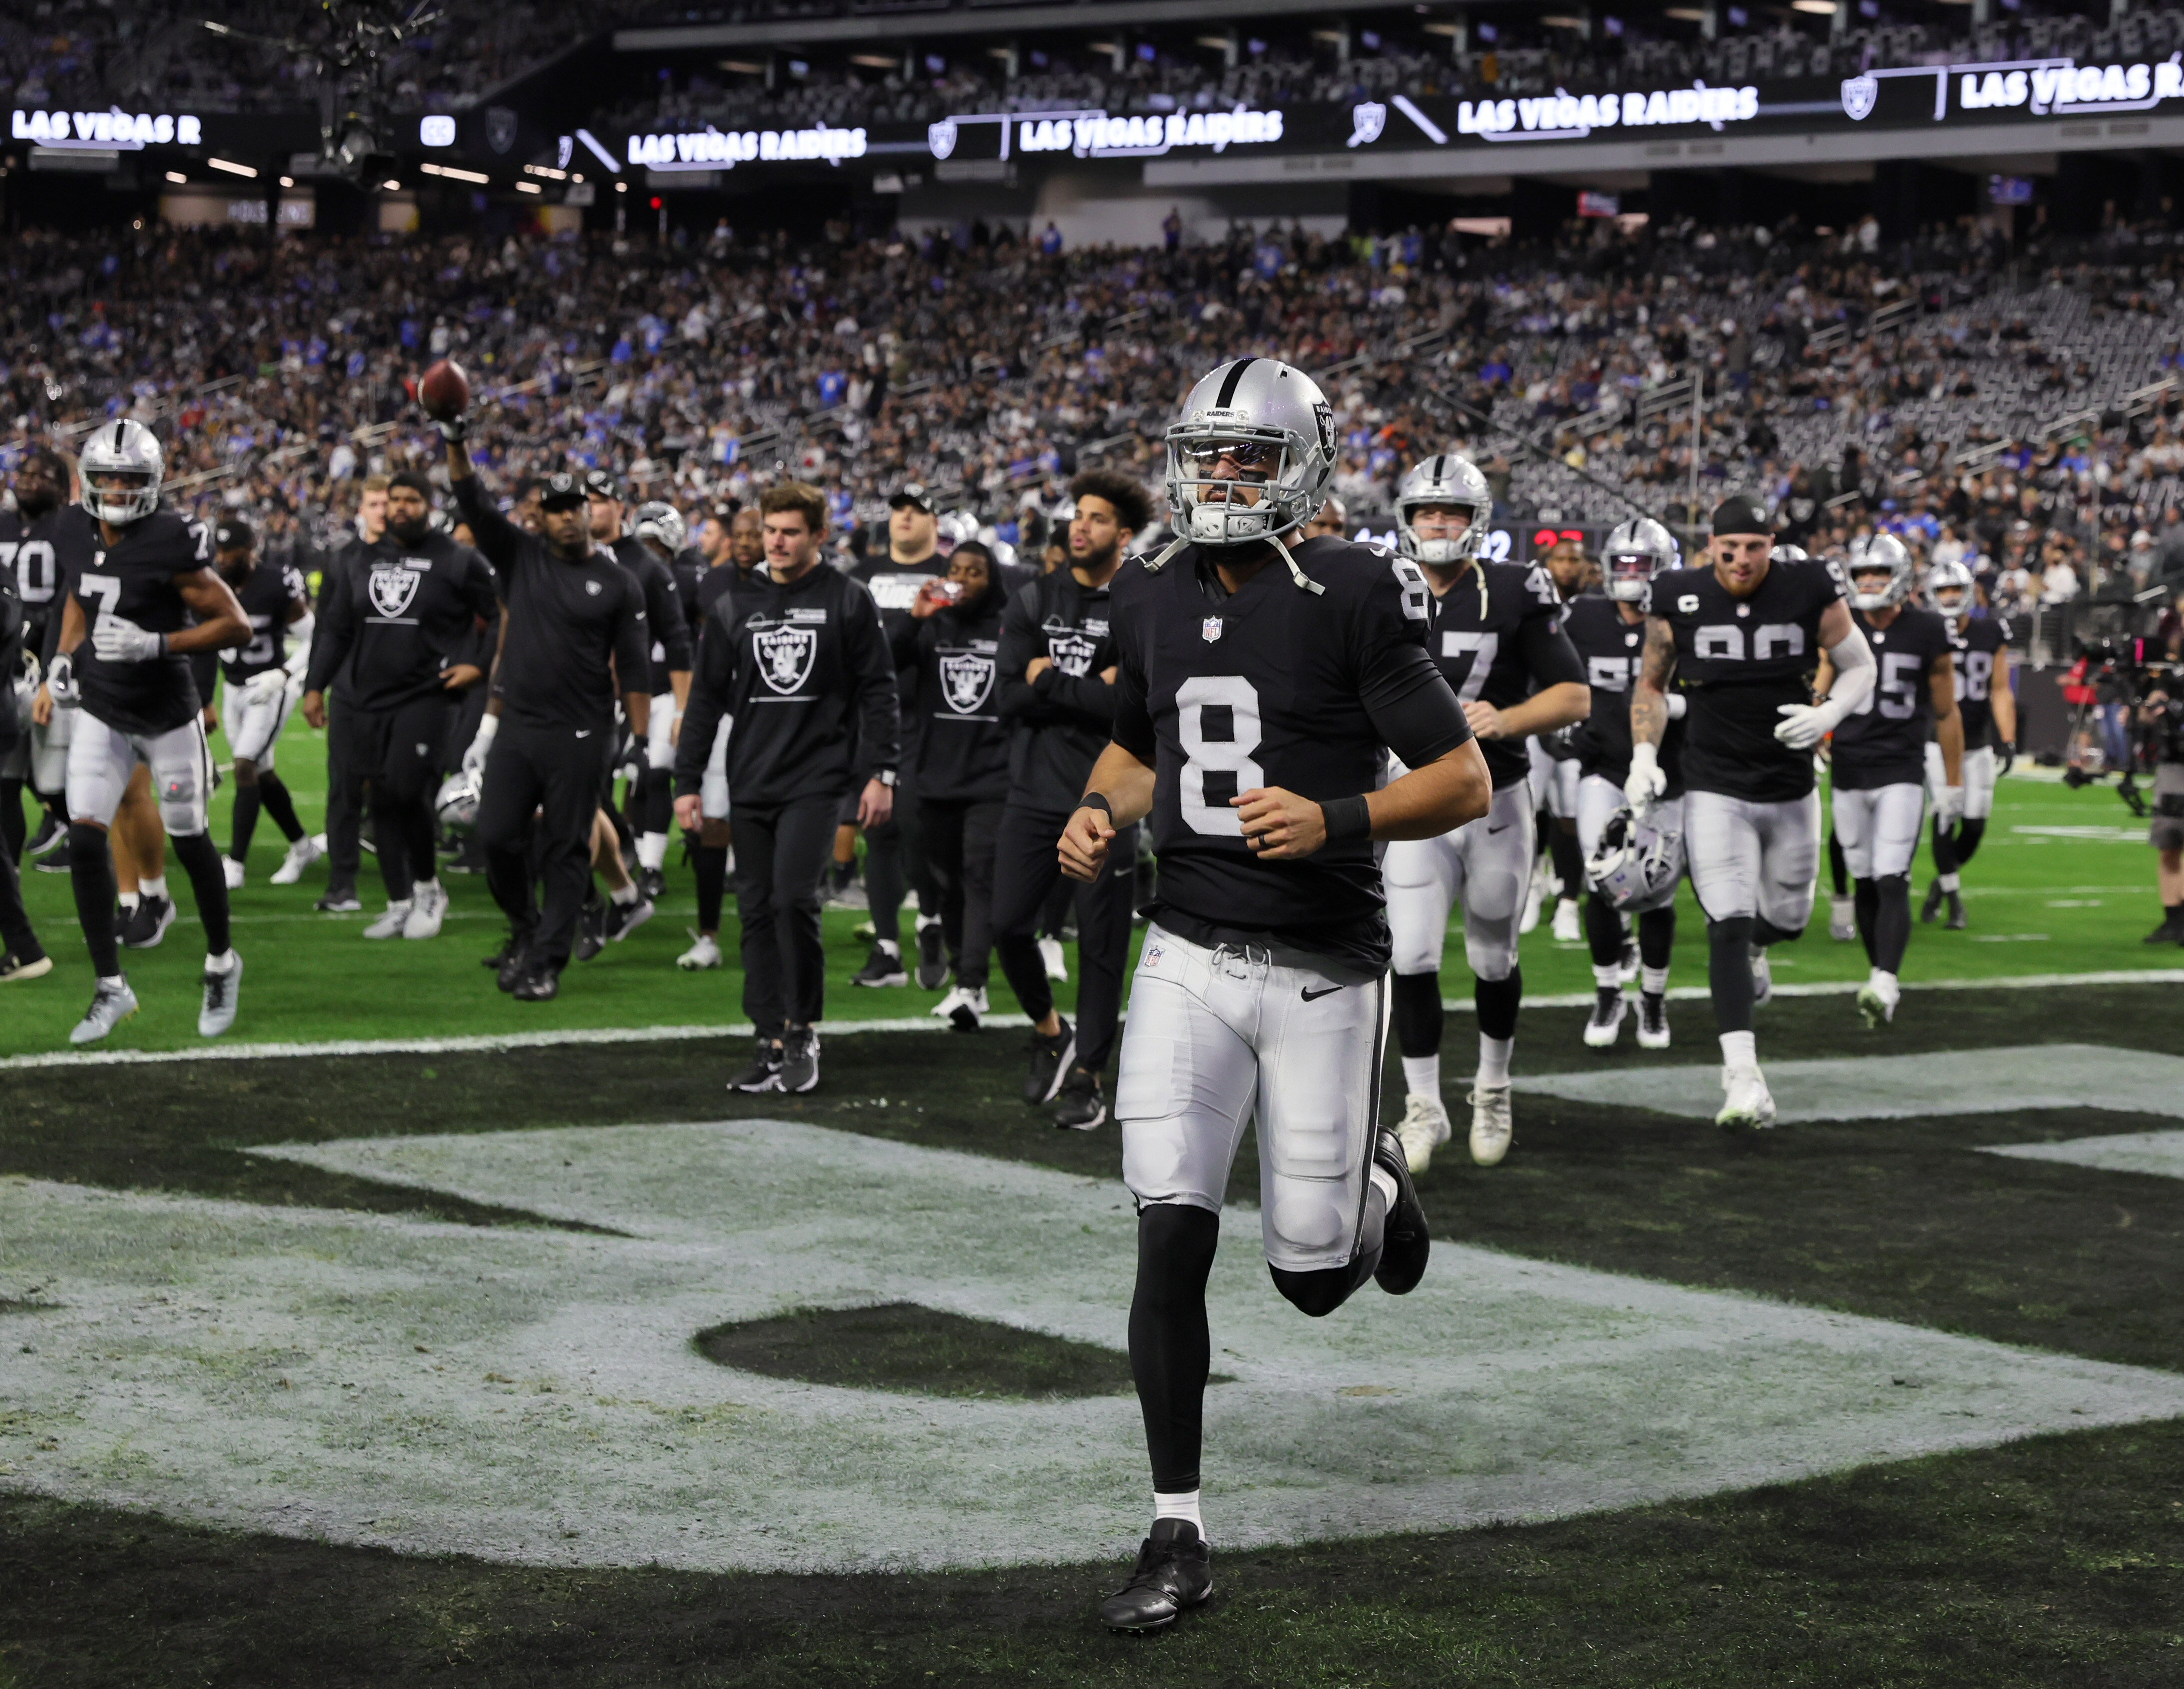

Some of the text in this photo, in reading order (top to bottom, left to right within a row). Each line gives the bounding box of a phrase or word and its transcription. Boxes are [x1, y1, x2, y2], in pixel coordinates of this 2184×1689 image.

[1960, 62, 2184, 109] LAS VEGAS R
[12, 110, 70, 140] LAS
[73, 111, 174, 144] VEGAS
[1457, 86, 1759, 133] LAS VEGAS RAIDERS
[628, 128, 867, 164] LAS VEGAS RAIDERS
[1019, 110, 1283, 152] LAS VEGAS RAIDERS
[188, 522, 209, 560] 7
[79, 572, 121, 614] 7
[1391, 557, 1429, 620] 8
[1677, 594, 1699, 613] C
[1205, 628, 1219, 638] NFL
[1175, 675, 1265, 837] 8
